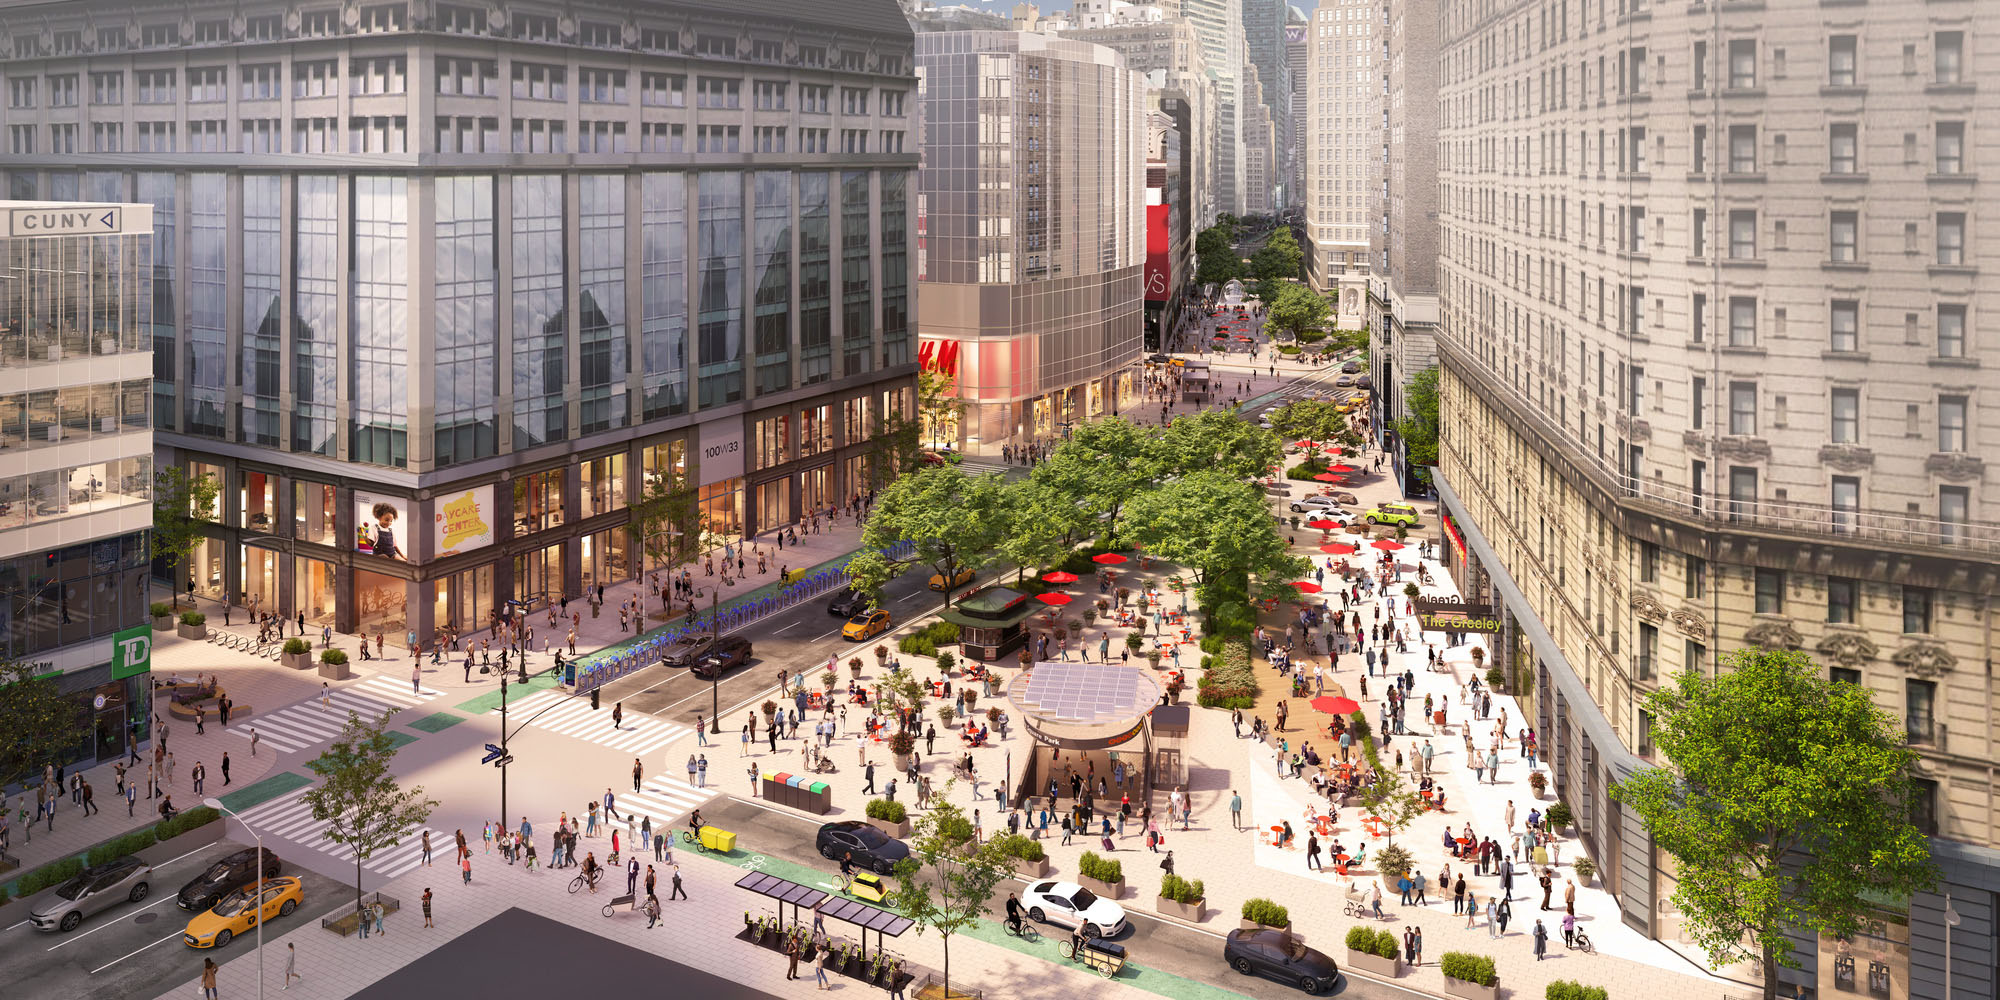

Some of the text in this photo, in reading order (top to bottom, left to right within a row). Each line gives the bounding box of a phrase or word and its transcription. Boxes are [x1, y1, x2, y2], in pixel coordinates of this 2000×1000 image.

[23, 213, 92, 230] CUNY
[705, 441, 739, 459] 100W33
[435, 503, 481, 523] DAYCARE
[442, 516, 481, 534] CENTER
[1421, 614, 1502, 633] The Greeley
[118, 635, 151, 668] TD
[1044, 735, 1061, 746] Park
